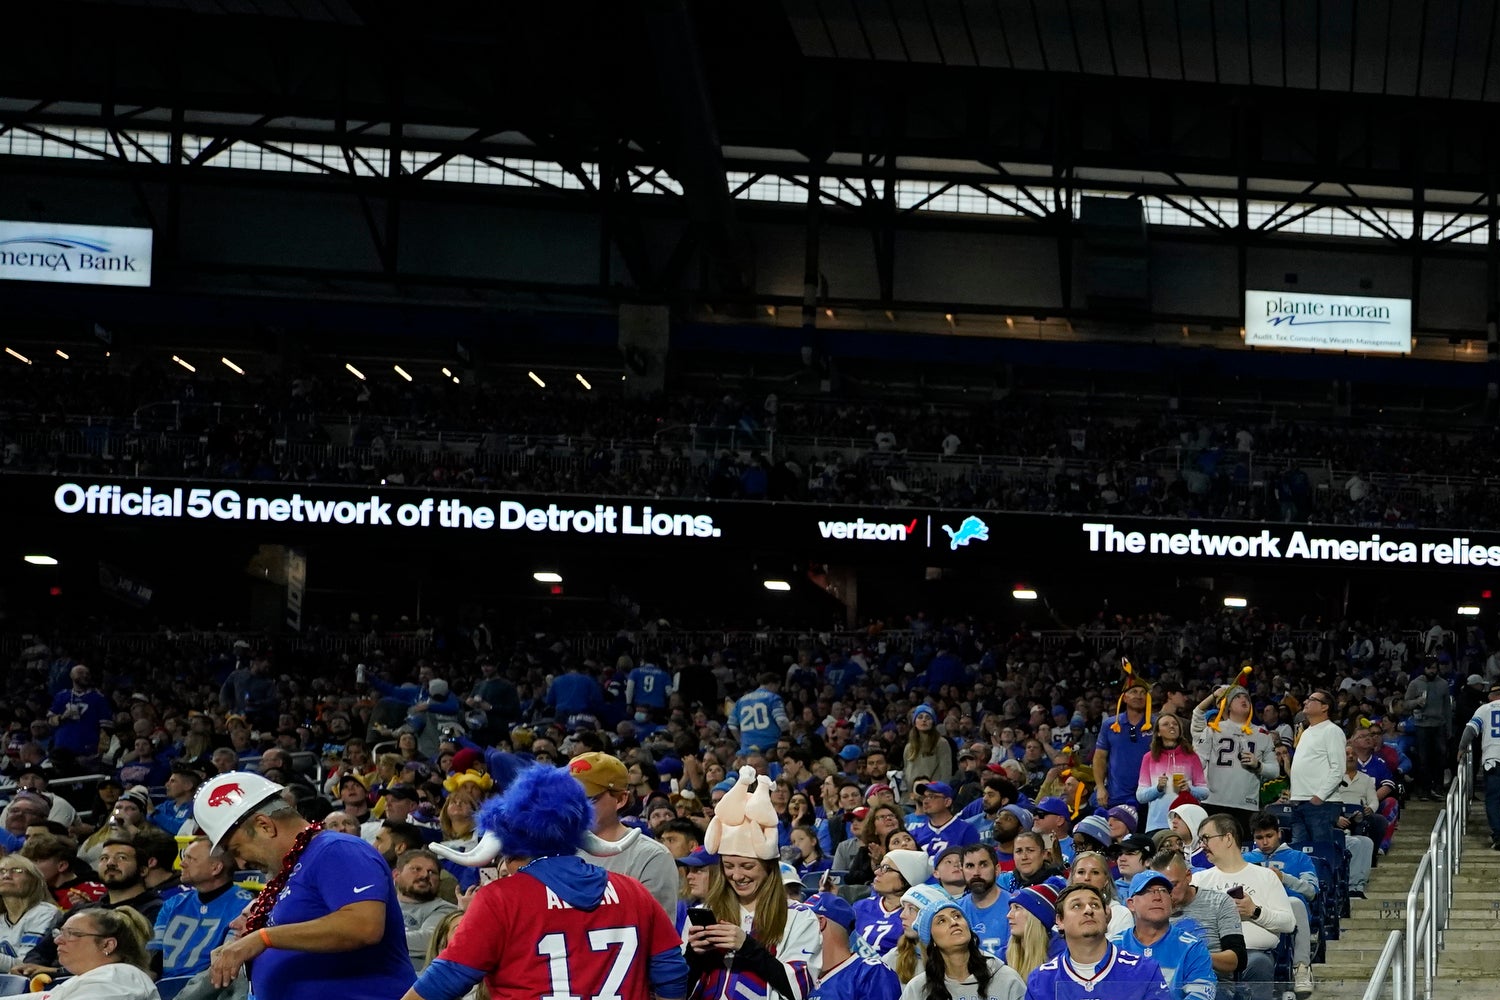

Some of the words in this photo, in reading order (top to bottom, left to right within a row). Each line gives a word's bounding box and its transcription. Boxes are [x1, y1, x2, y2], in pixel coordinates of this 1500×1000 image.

[80, 252, 136, 272] Bank
[1266, 298, 1324, 316] plante
[1331, 303, 1390, 319] moran
[54, 483, 183, 517] Official
[186, 488, 242, 520] 5G
[246, 493, 393, 526] network
[396, 498, 433, 527] of
[436, 499, 495, 530] the
[499, 500, 618, 534] Detroit
[621, 505, 722, 538] Lions.
[817, 517, 907, 541] verizon
[1082, 522, 1147, 554] The
[1149, 525, 1281, 558] network
[1284, 530, 1418, 563] America
[643, 674, 655, 693] 9
[740, 702, 770, 732] 20
[162, 915, 222, 968] 97
[862, 924, 894, 952] 17
